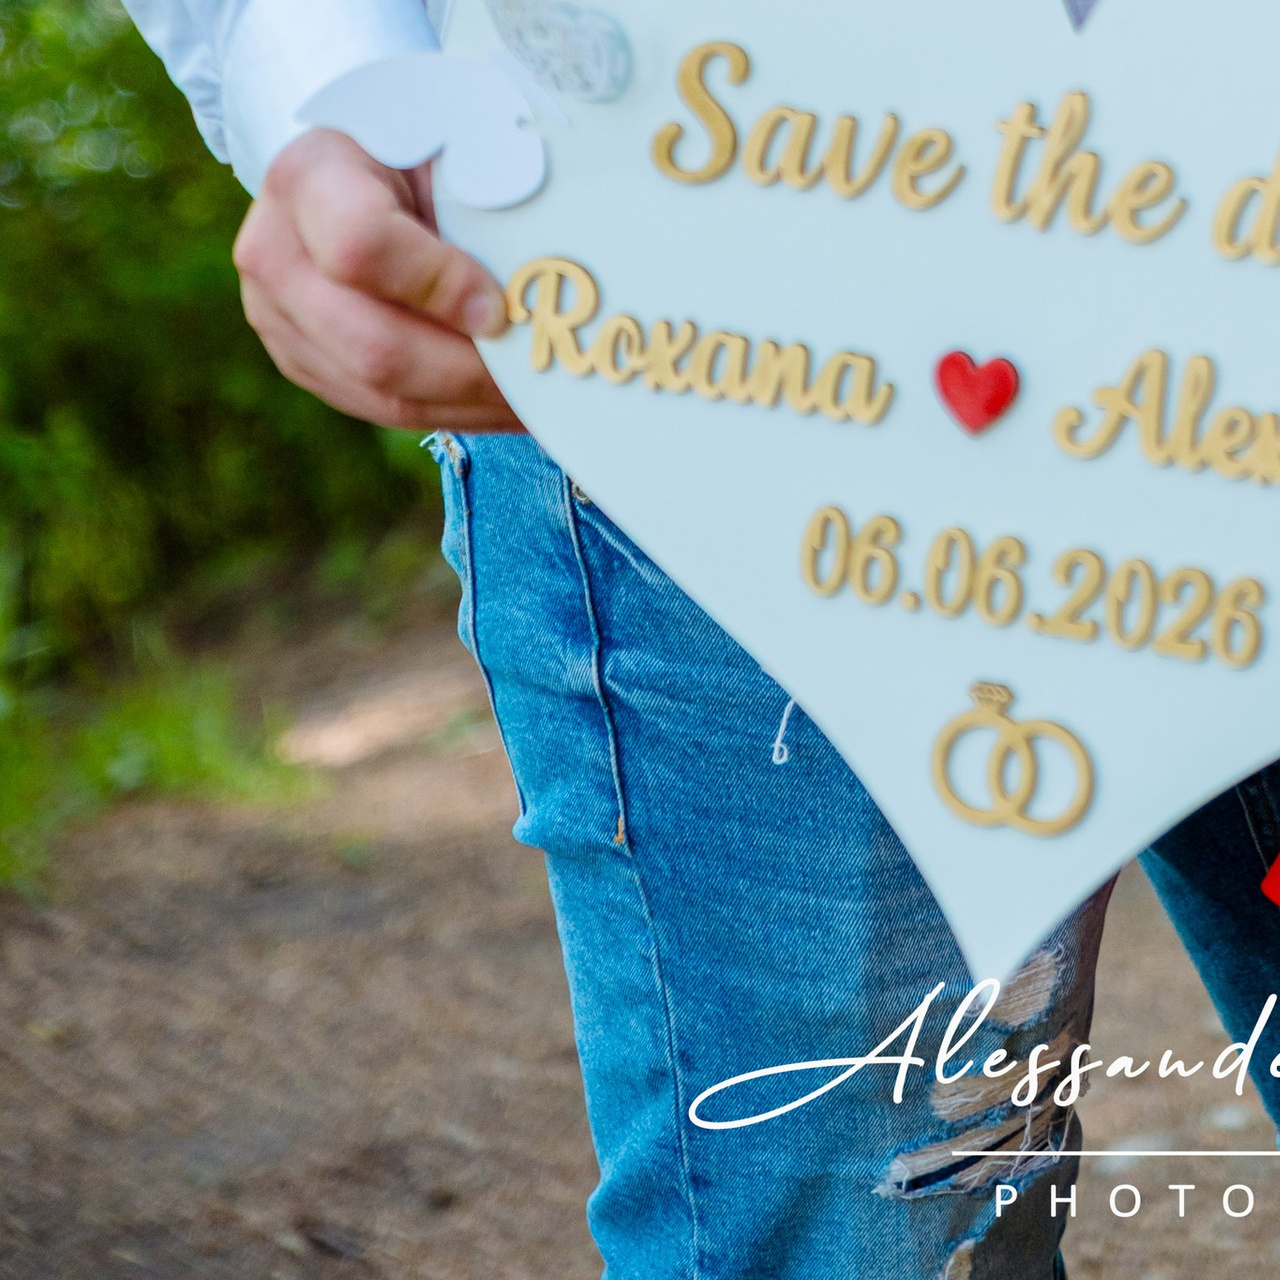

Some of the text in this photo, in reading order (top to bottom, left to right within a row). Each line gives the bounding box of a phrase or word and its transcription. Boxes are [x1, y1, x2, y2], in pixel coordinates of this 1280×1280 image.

[652, 42, 966, 210] Save
[992, 91, 1187, 243] the
[507, 257, 895, 424] Roxana
[802, 505, 1266, 668] 06.06.2026
